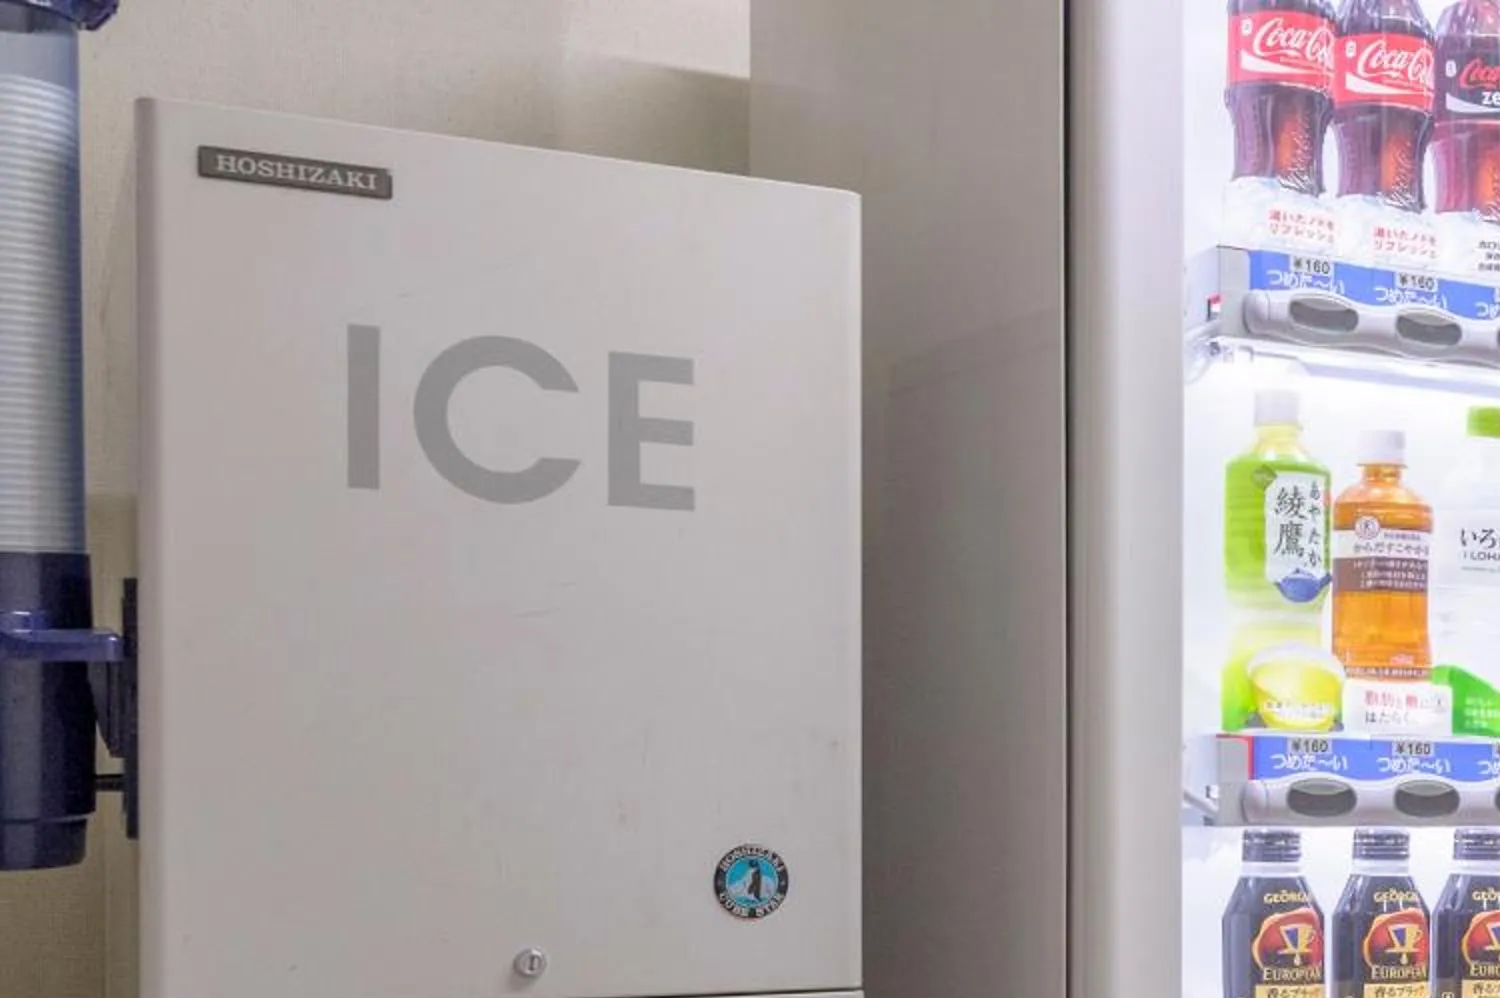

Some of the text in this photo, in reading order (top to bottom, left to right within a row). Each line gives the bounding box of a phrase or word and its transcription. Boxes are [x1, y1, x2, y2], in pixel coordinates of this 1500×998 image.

[216, 153, 377, 192] HOSHIZAKI
[346, 323, 695, 512] ICE
[1275, 485, 1307, 558] 綾鷹
